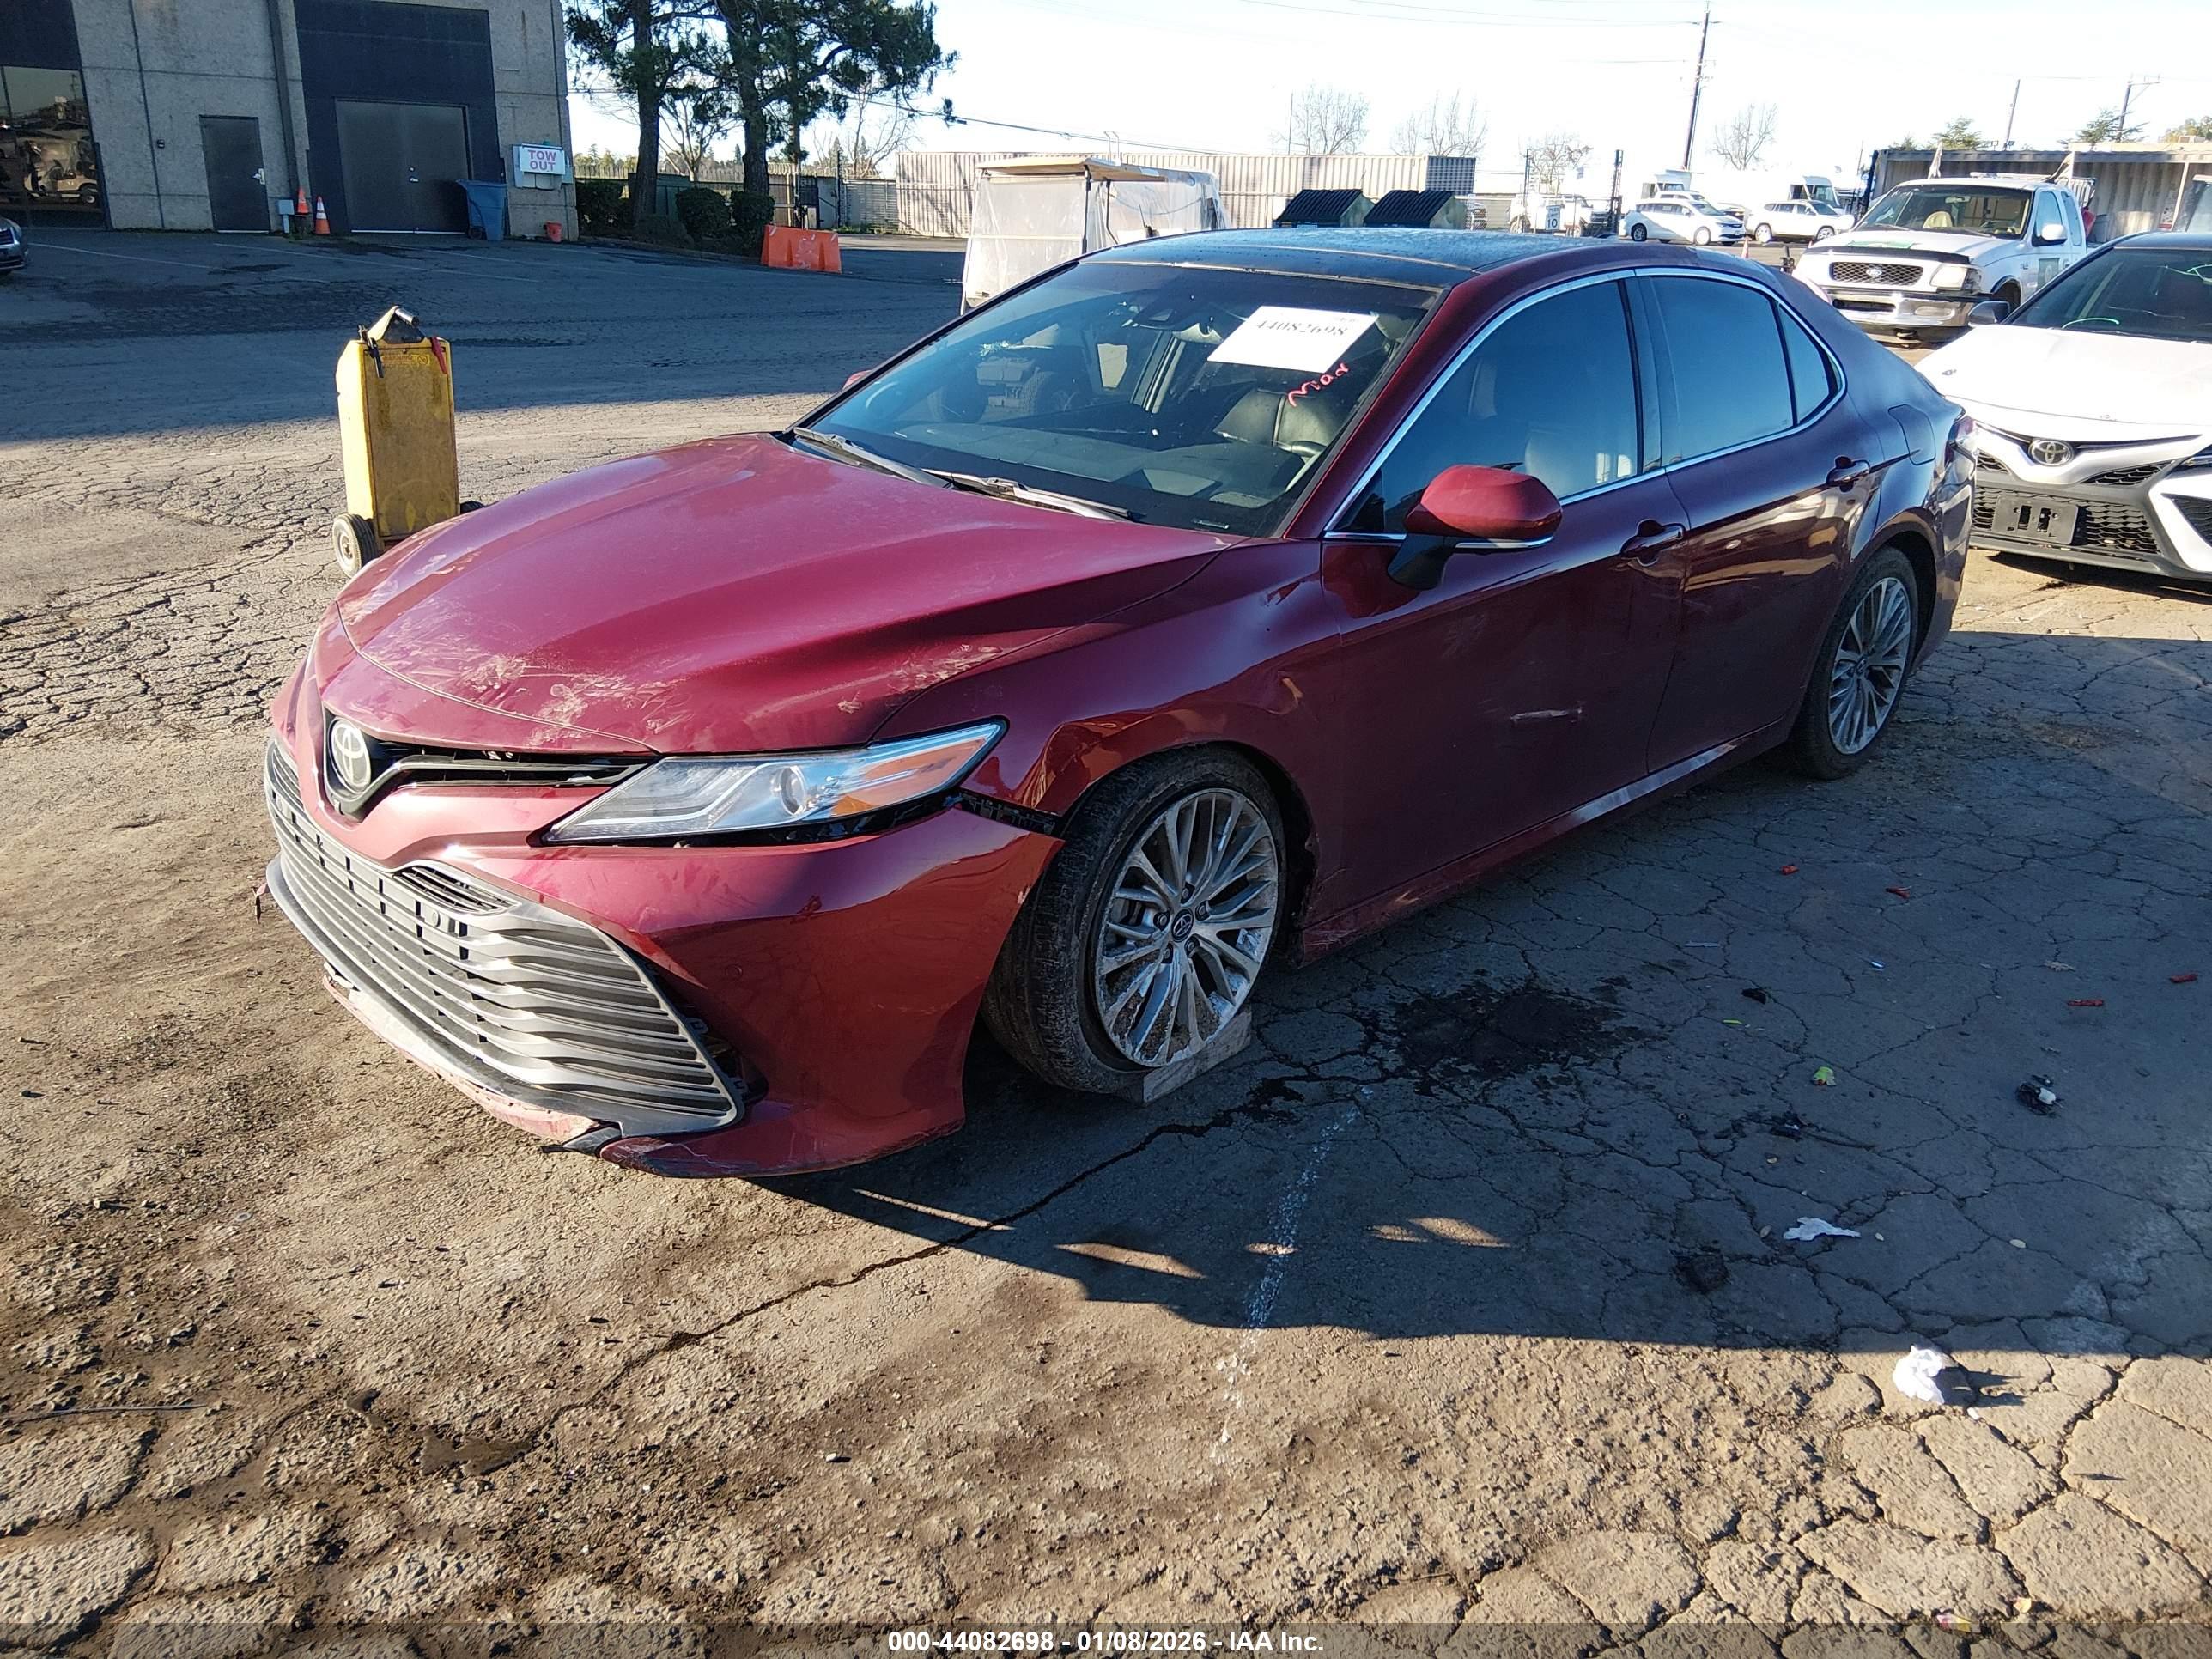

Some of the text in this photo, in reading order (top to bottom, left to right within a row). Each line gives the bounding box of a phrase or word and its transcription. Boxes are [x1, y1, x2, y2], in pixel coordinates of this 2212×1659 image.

[528, 149, 556, 161] TOW
[529, 161, 556, 172] OUT
[1547, 218, 1559, 228] 10
[1256, 319, 1348, 337] 44082698
